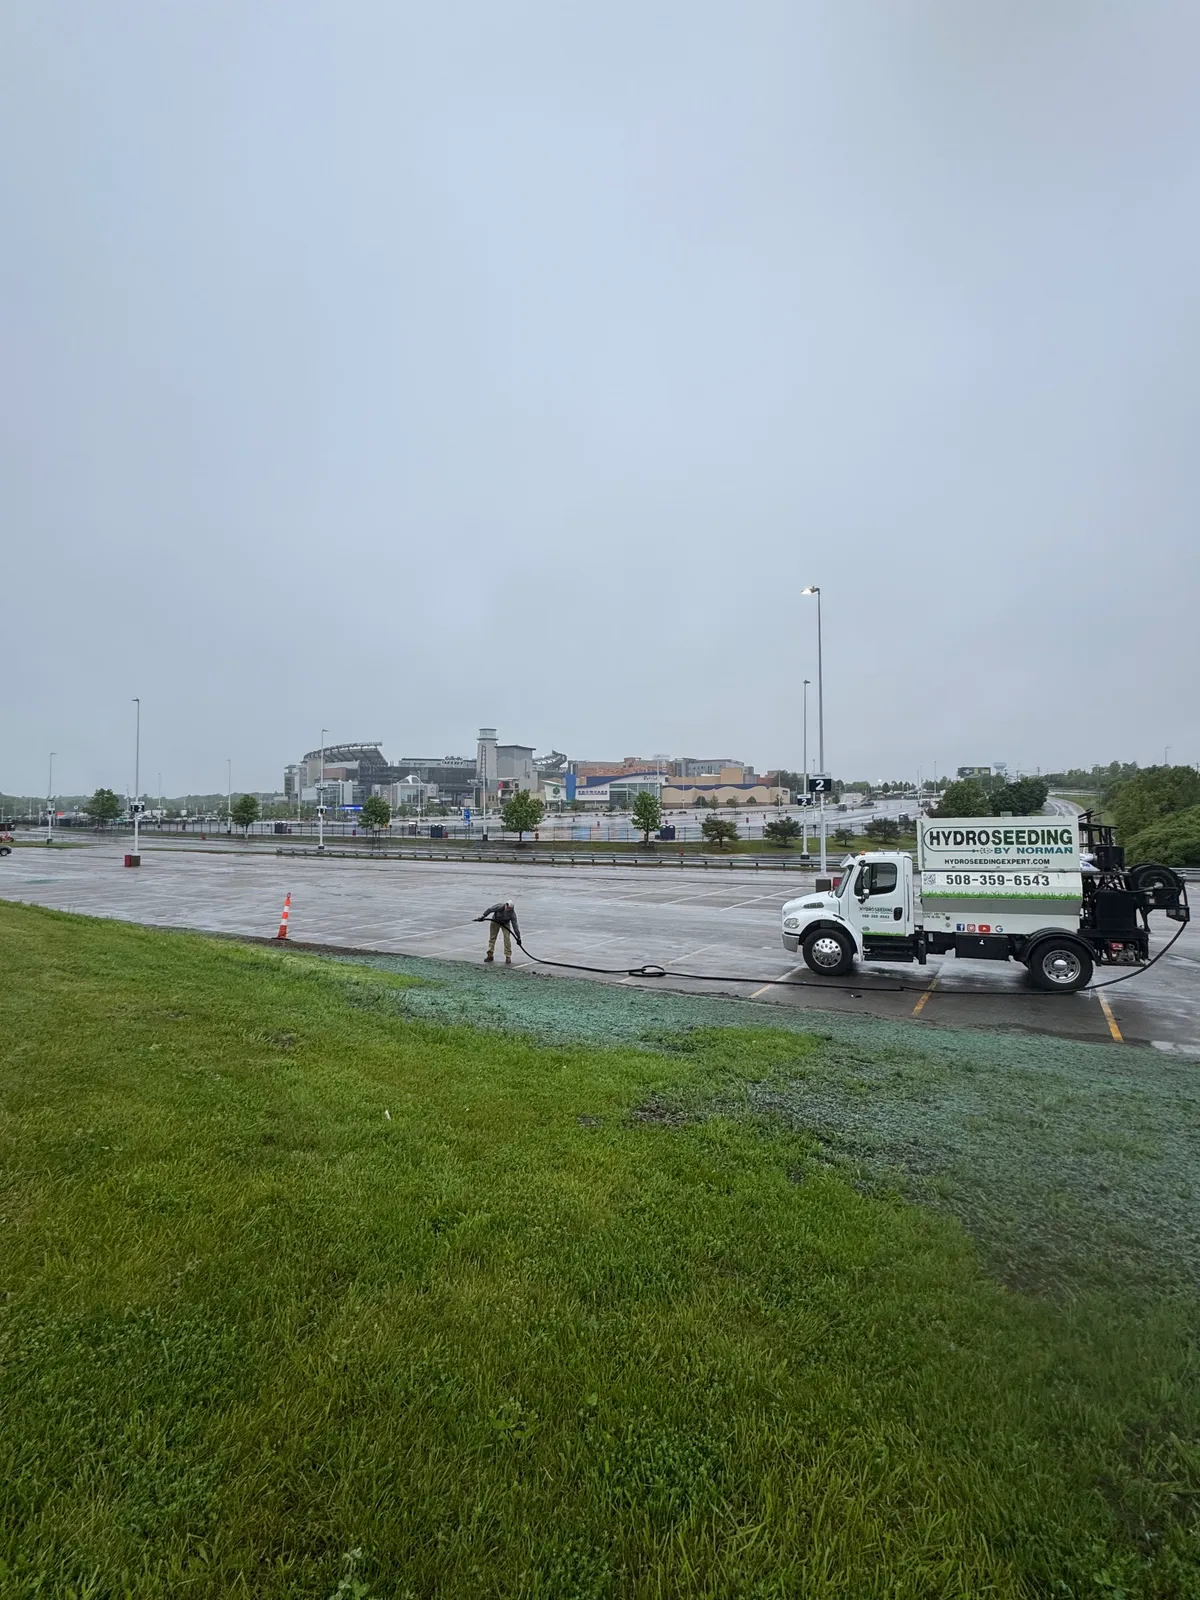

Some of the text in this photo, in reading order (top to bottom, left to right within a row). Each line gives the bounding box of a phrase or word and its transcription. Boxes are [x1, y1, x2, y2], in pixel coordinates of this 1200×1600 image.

[816, 780, 824, 790] 2
[929, 829, 1073, 846] HYDROSEEDING
[1017, 846, 1073, 854] NORMAN
[946, 874, 1050, 886] 508-359-6543
